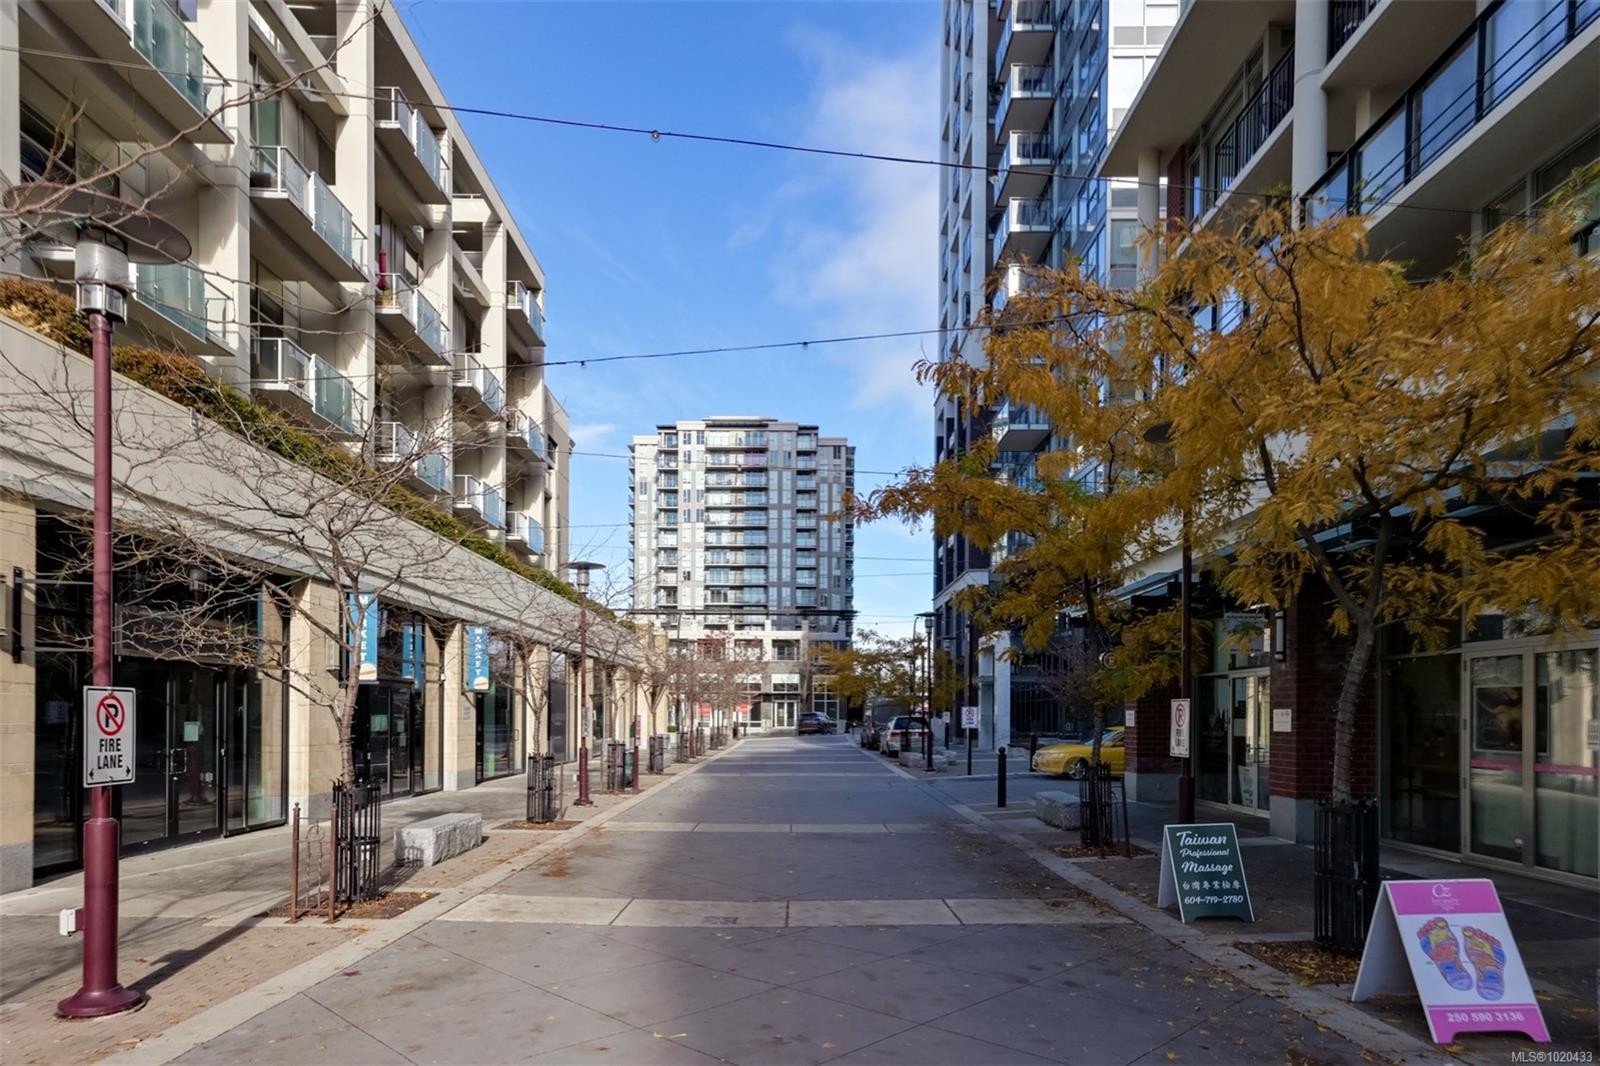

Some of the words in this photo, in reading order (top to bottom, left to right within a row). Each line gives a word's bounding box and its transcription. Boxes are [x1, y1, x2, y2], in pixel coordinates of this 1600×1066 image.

[99, 738, 122, 753] FIRE
[97, 754, 123, 770] LANE
[1176, 831, 1227, 846] Taiwan
[1180, 848, 1230, 858] Professional
[1181, 861, 1233, 875] Massage
[1447, 1012, 1469, 1023] 250
